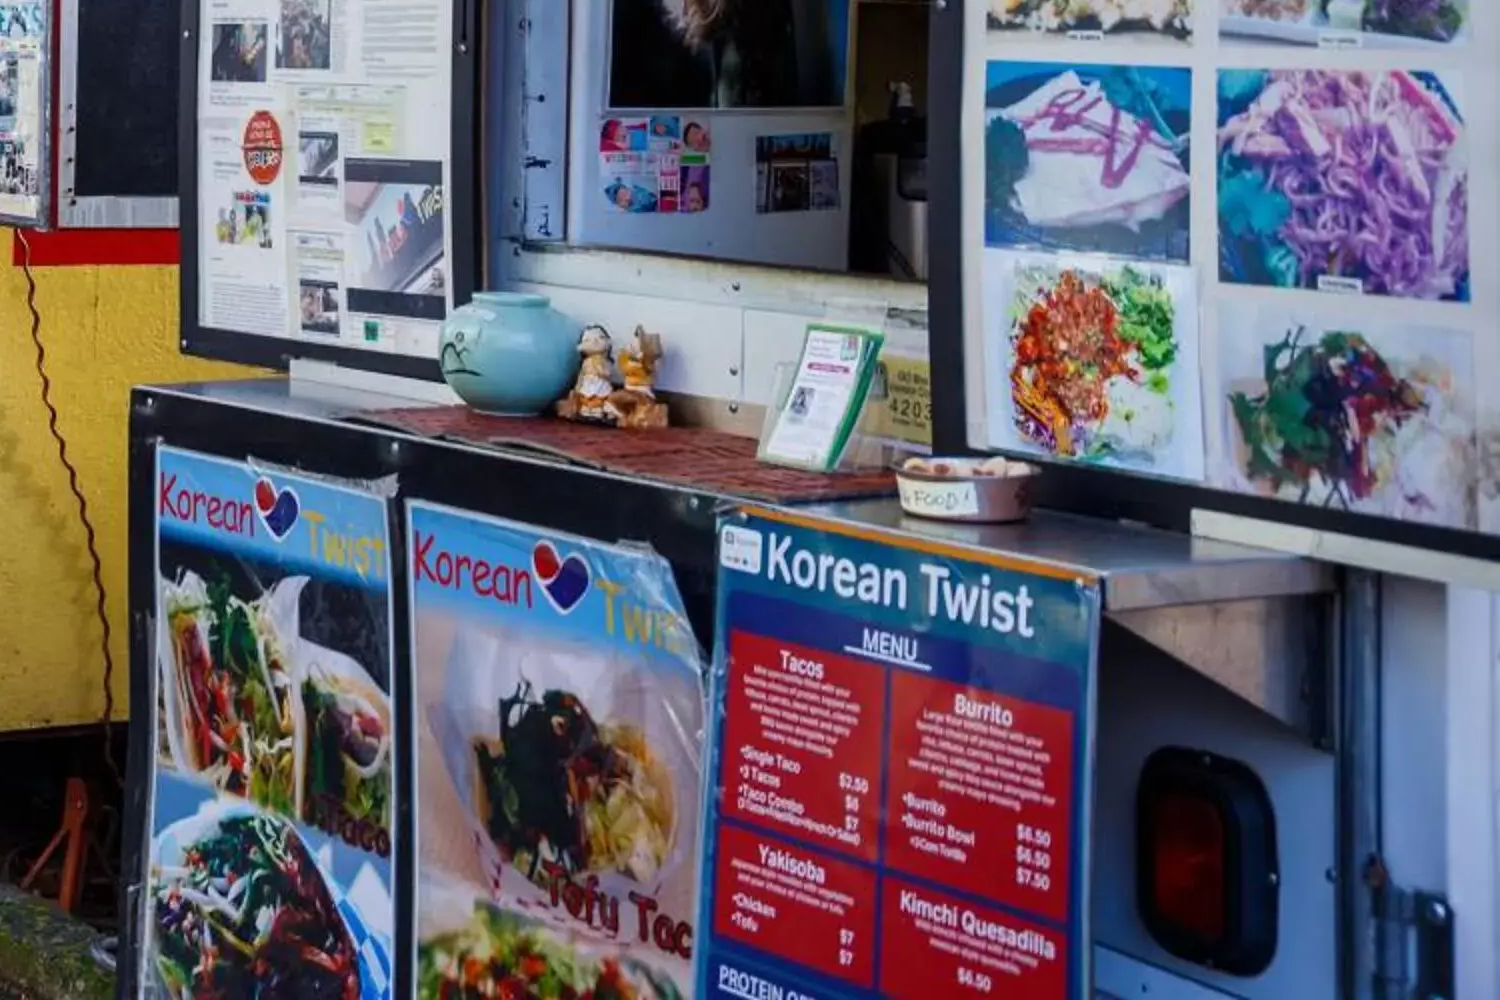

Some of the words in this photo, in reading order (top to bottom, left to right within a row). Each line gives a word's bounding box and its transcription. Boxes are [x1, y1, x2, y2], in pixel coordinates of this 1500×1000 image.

[158, 470, 255, 537] Korean
[413, 529, 533, 609] Korean
[767, 533, 908, 607] Korean
[920, 564, 1035, 638] Twist
[863, 629, 918, 661] MENU
[780, 649, 824, 680] Tacos
[954, 692, 1013, 728] Burrito
[752, 766, 780, 788] Tacos
[776, 754, 801, 774] Taco
[743, 783, 766, 803] Taco
[906, 792, 947, 817] Burrito
[904, 812, 945, 838] Burrito
[947, 824, 975, 848] Bowl
[759, 844, 826, 885] Yakisoba
[543, 861, 619, 937] Tofu
[900, 890, 958, 927] Kimchi
[961, 910, 1057, 960] Quesadilla
